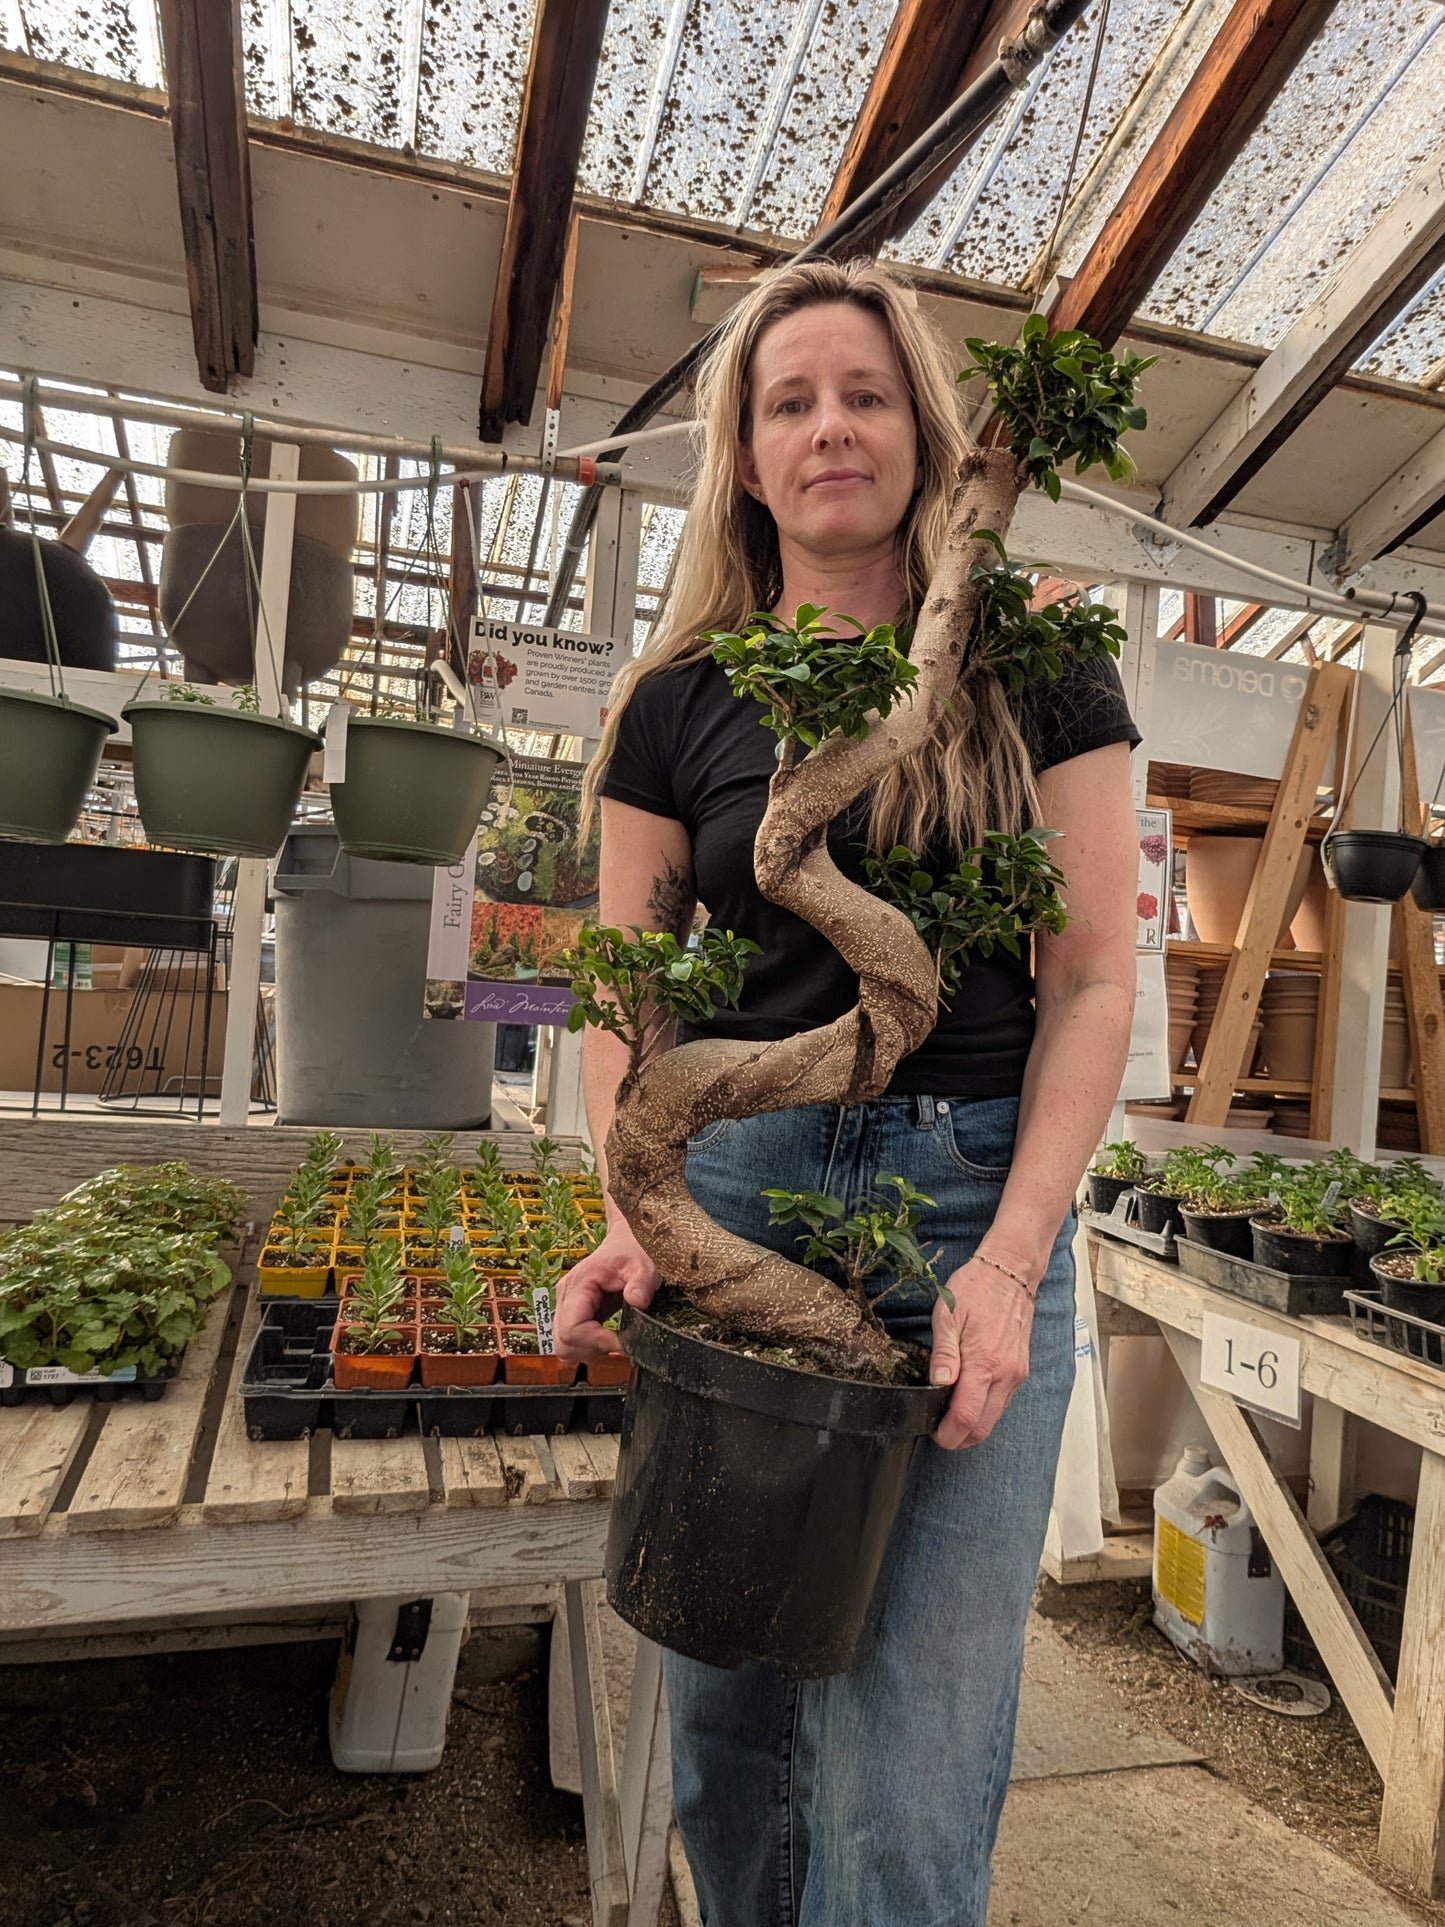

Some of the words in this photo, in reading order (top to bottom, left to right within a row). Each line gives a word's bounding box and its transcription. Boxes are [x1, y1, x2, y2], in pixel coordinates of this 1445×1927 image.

[475, 622, 508, 640] Did
[512, 630, 548, 647] you
[552, 632, 614, 656] know?
[528, 649, 553, 660] Proven
[588, 659, 610, 668] plants
[526, 668, 549, 678] grown
[551, 672, 560, 680] by
[540, 662, 568, 672] proudly
[570, 666, 605, 676] produced
[524, 688, 554, 698] Canada.
[525, 678, 540, 686] and
[541, 681, 568, 690] garden
[569, 684, 596, 694] centres
[511, 760, 552, 772] Miniature
[1141, 816, 1156, 828] the
[443, 884, 468, 928] Fairy
[52, 1044, 165, 1071] T623-2
[1224, 1338, 1280, 1388] 1-6
